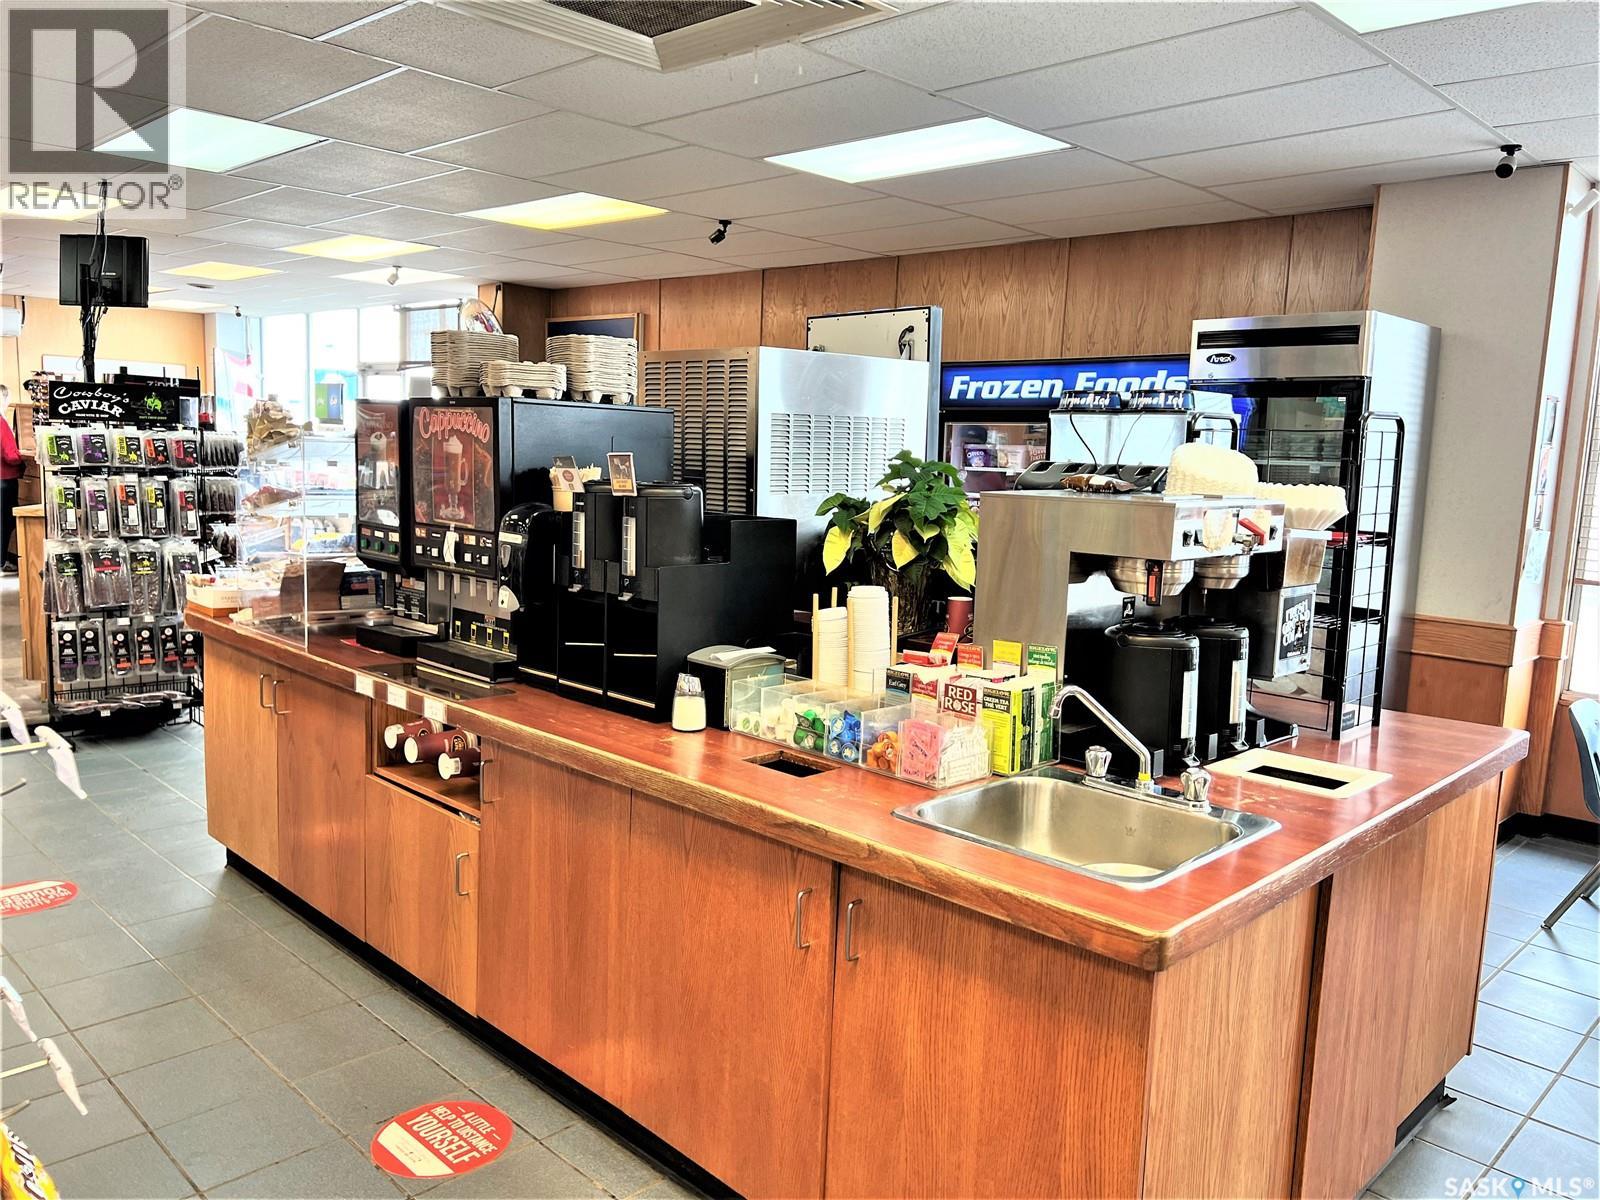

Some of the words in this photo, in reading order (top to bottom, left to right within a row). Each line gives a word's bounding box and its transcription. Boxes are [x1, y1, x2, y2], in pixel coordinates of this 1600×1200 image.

[53, 386, 130, 404] Cowboy's
[950, 374, 1063, 400] Frozen
[1074, 369, 1188, 392] Foods
[58, 399, 125, 418] CAVIAR
[418, 406, 491, 443] Cappuccino
[948, 686, 973, 701] RED
[430, 1105, 456, 1124] HELP
[450, 1116, 466, 1129] TO
[458, 1124, 498, 1155] DISTANCE
[468, 1115, 496, 1134] LITTLE
[406, 1112, 481, 1164] YOURSELF
